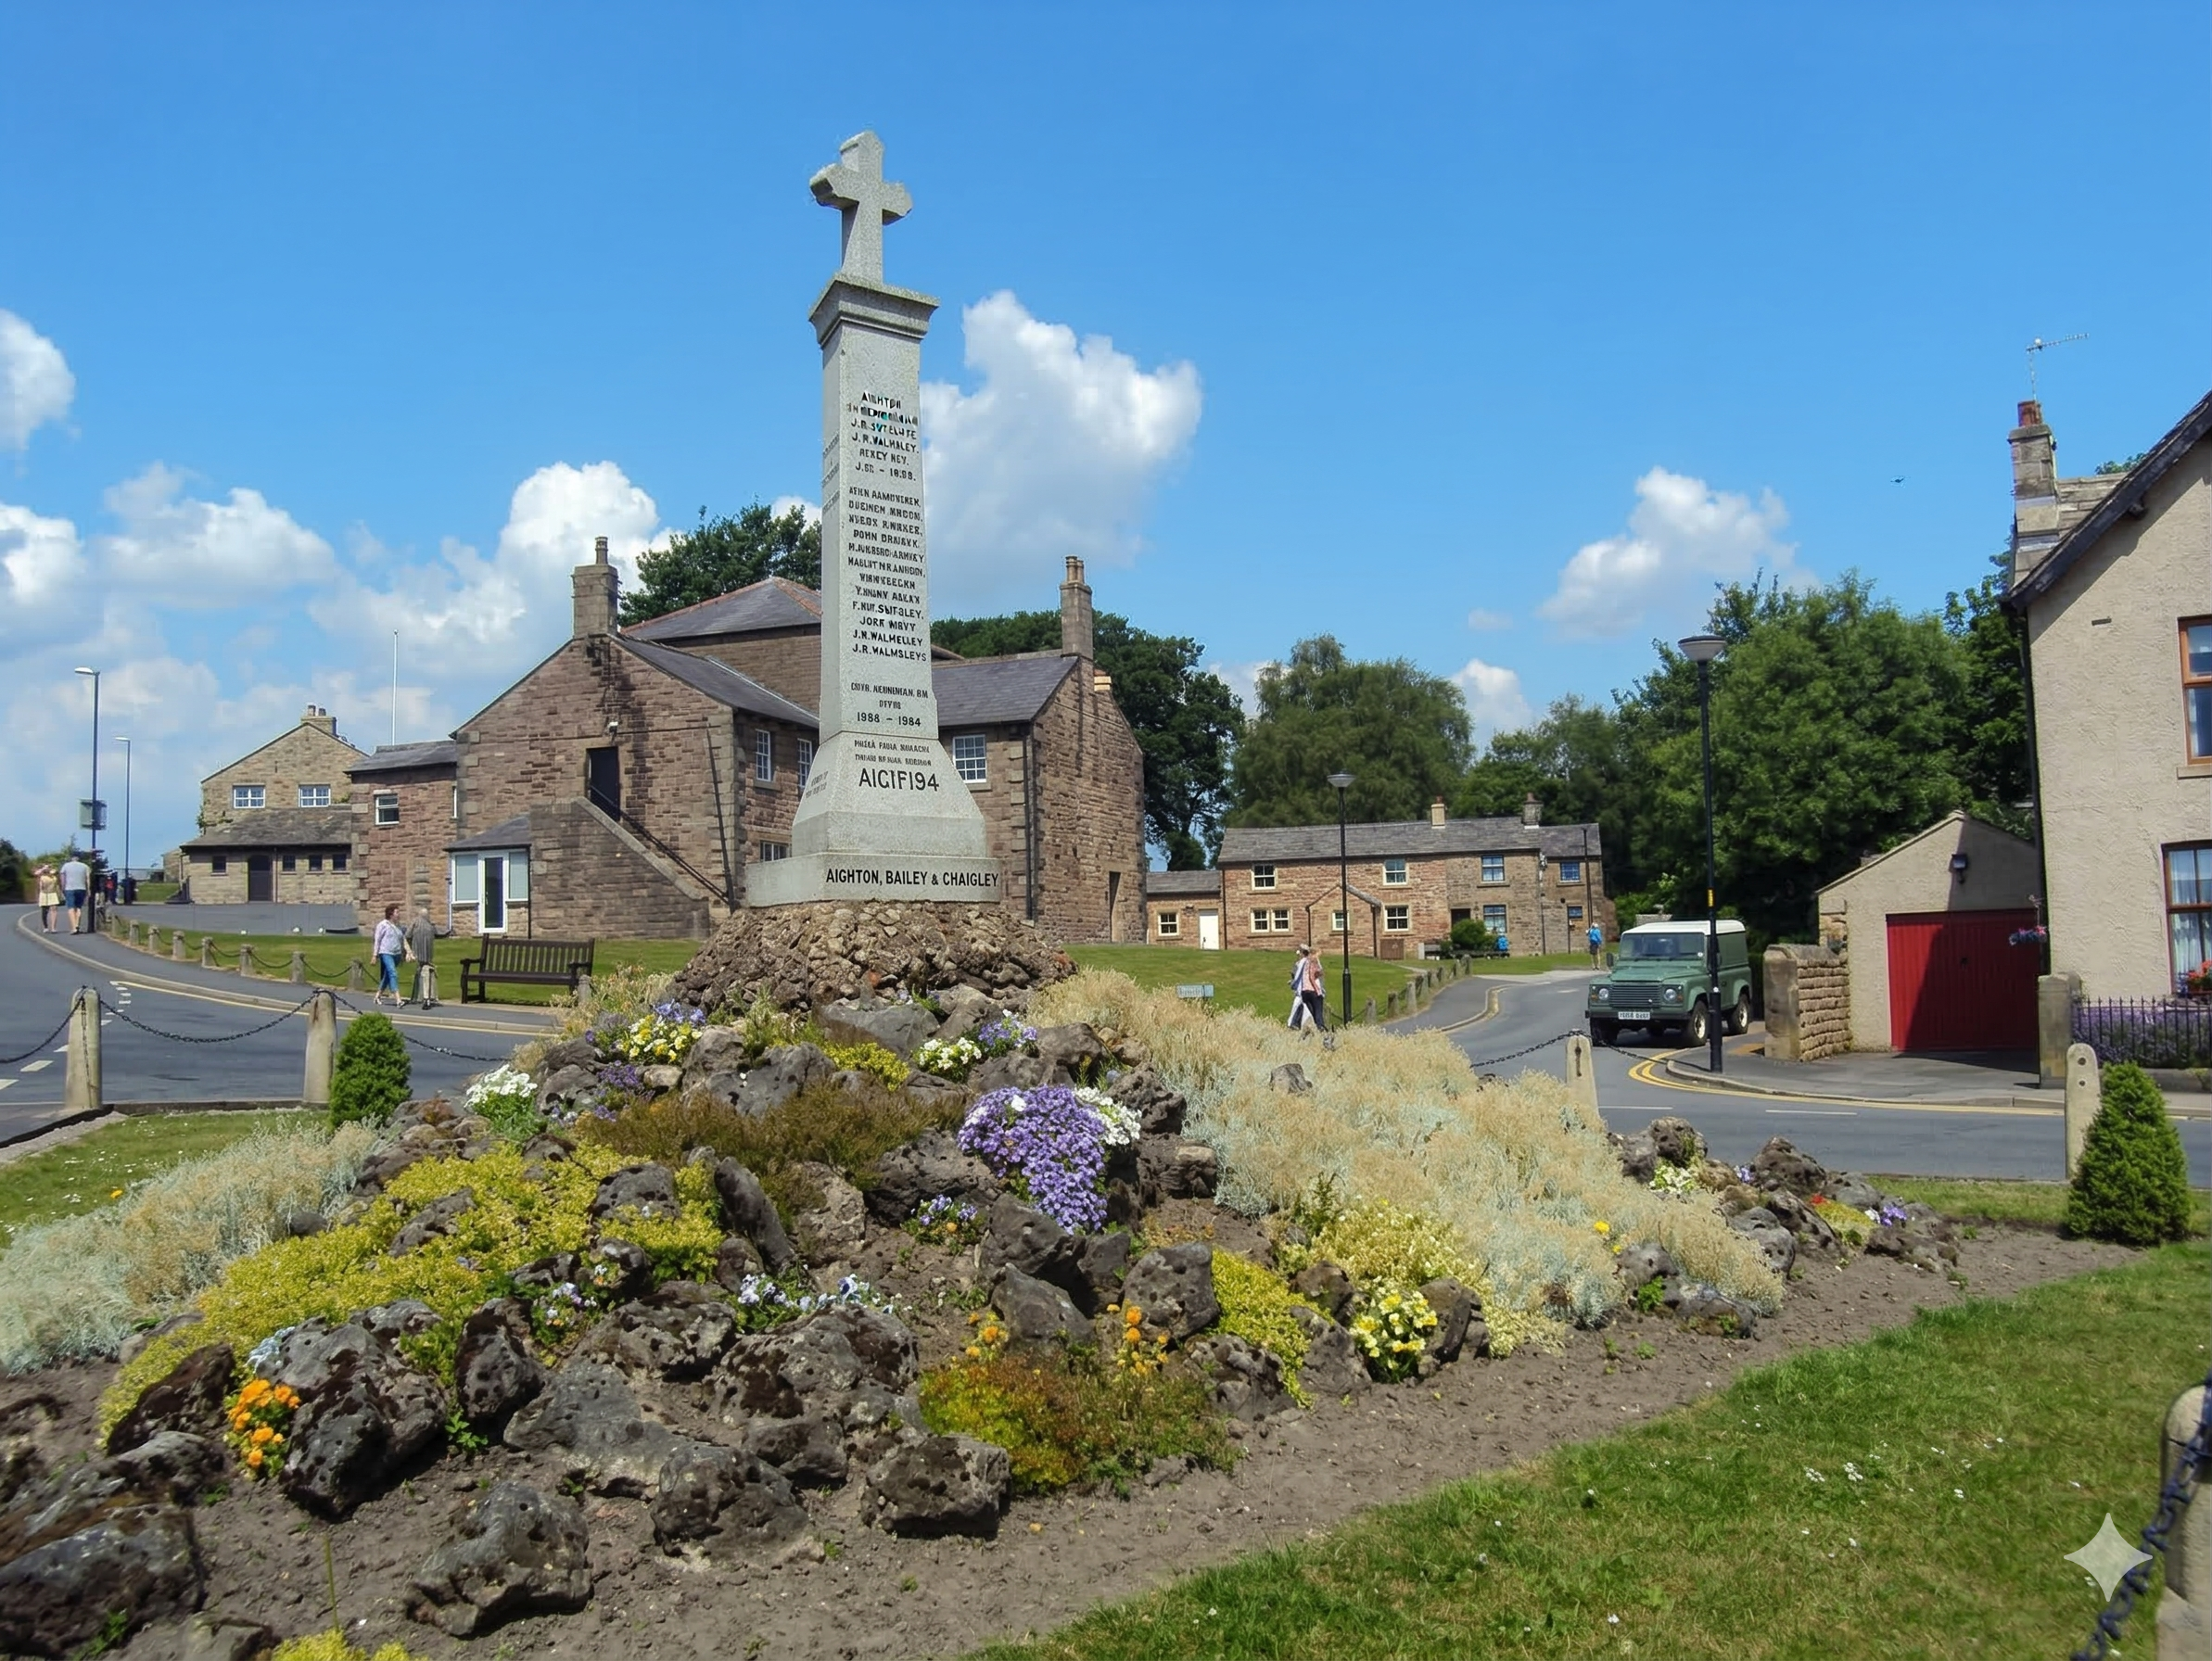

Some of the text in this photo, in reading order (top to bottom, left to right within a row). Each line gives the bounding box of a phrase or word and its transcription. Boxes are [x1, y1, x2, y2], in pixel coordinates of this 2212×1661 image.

[858, 712, 880, 723] 1988
[898, 716, 922, 727] 1984
[826, 868, 999, 887] AIGHTON, BAILEY & CHAIGLEY
